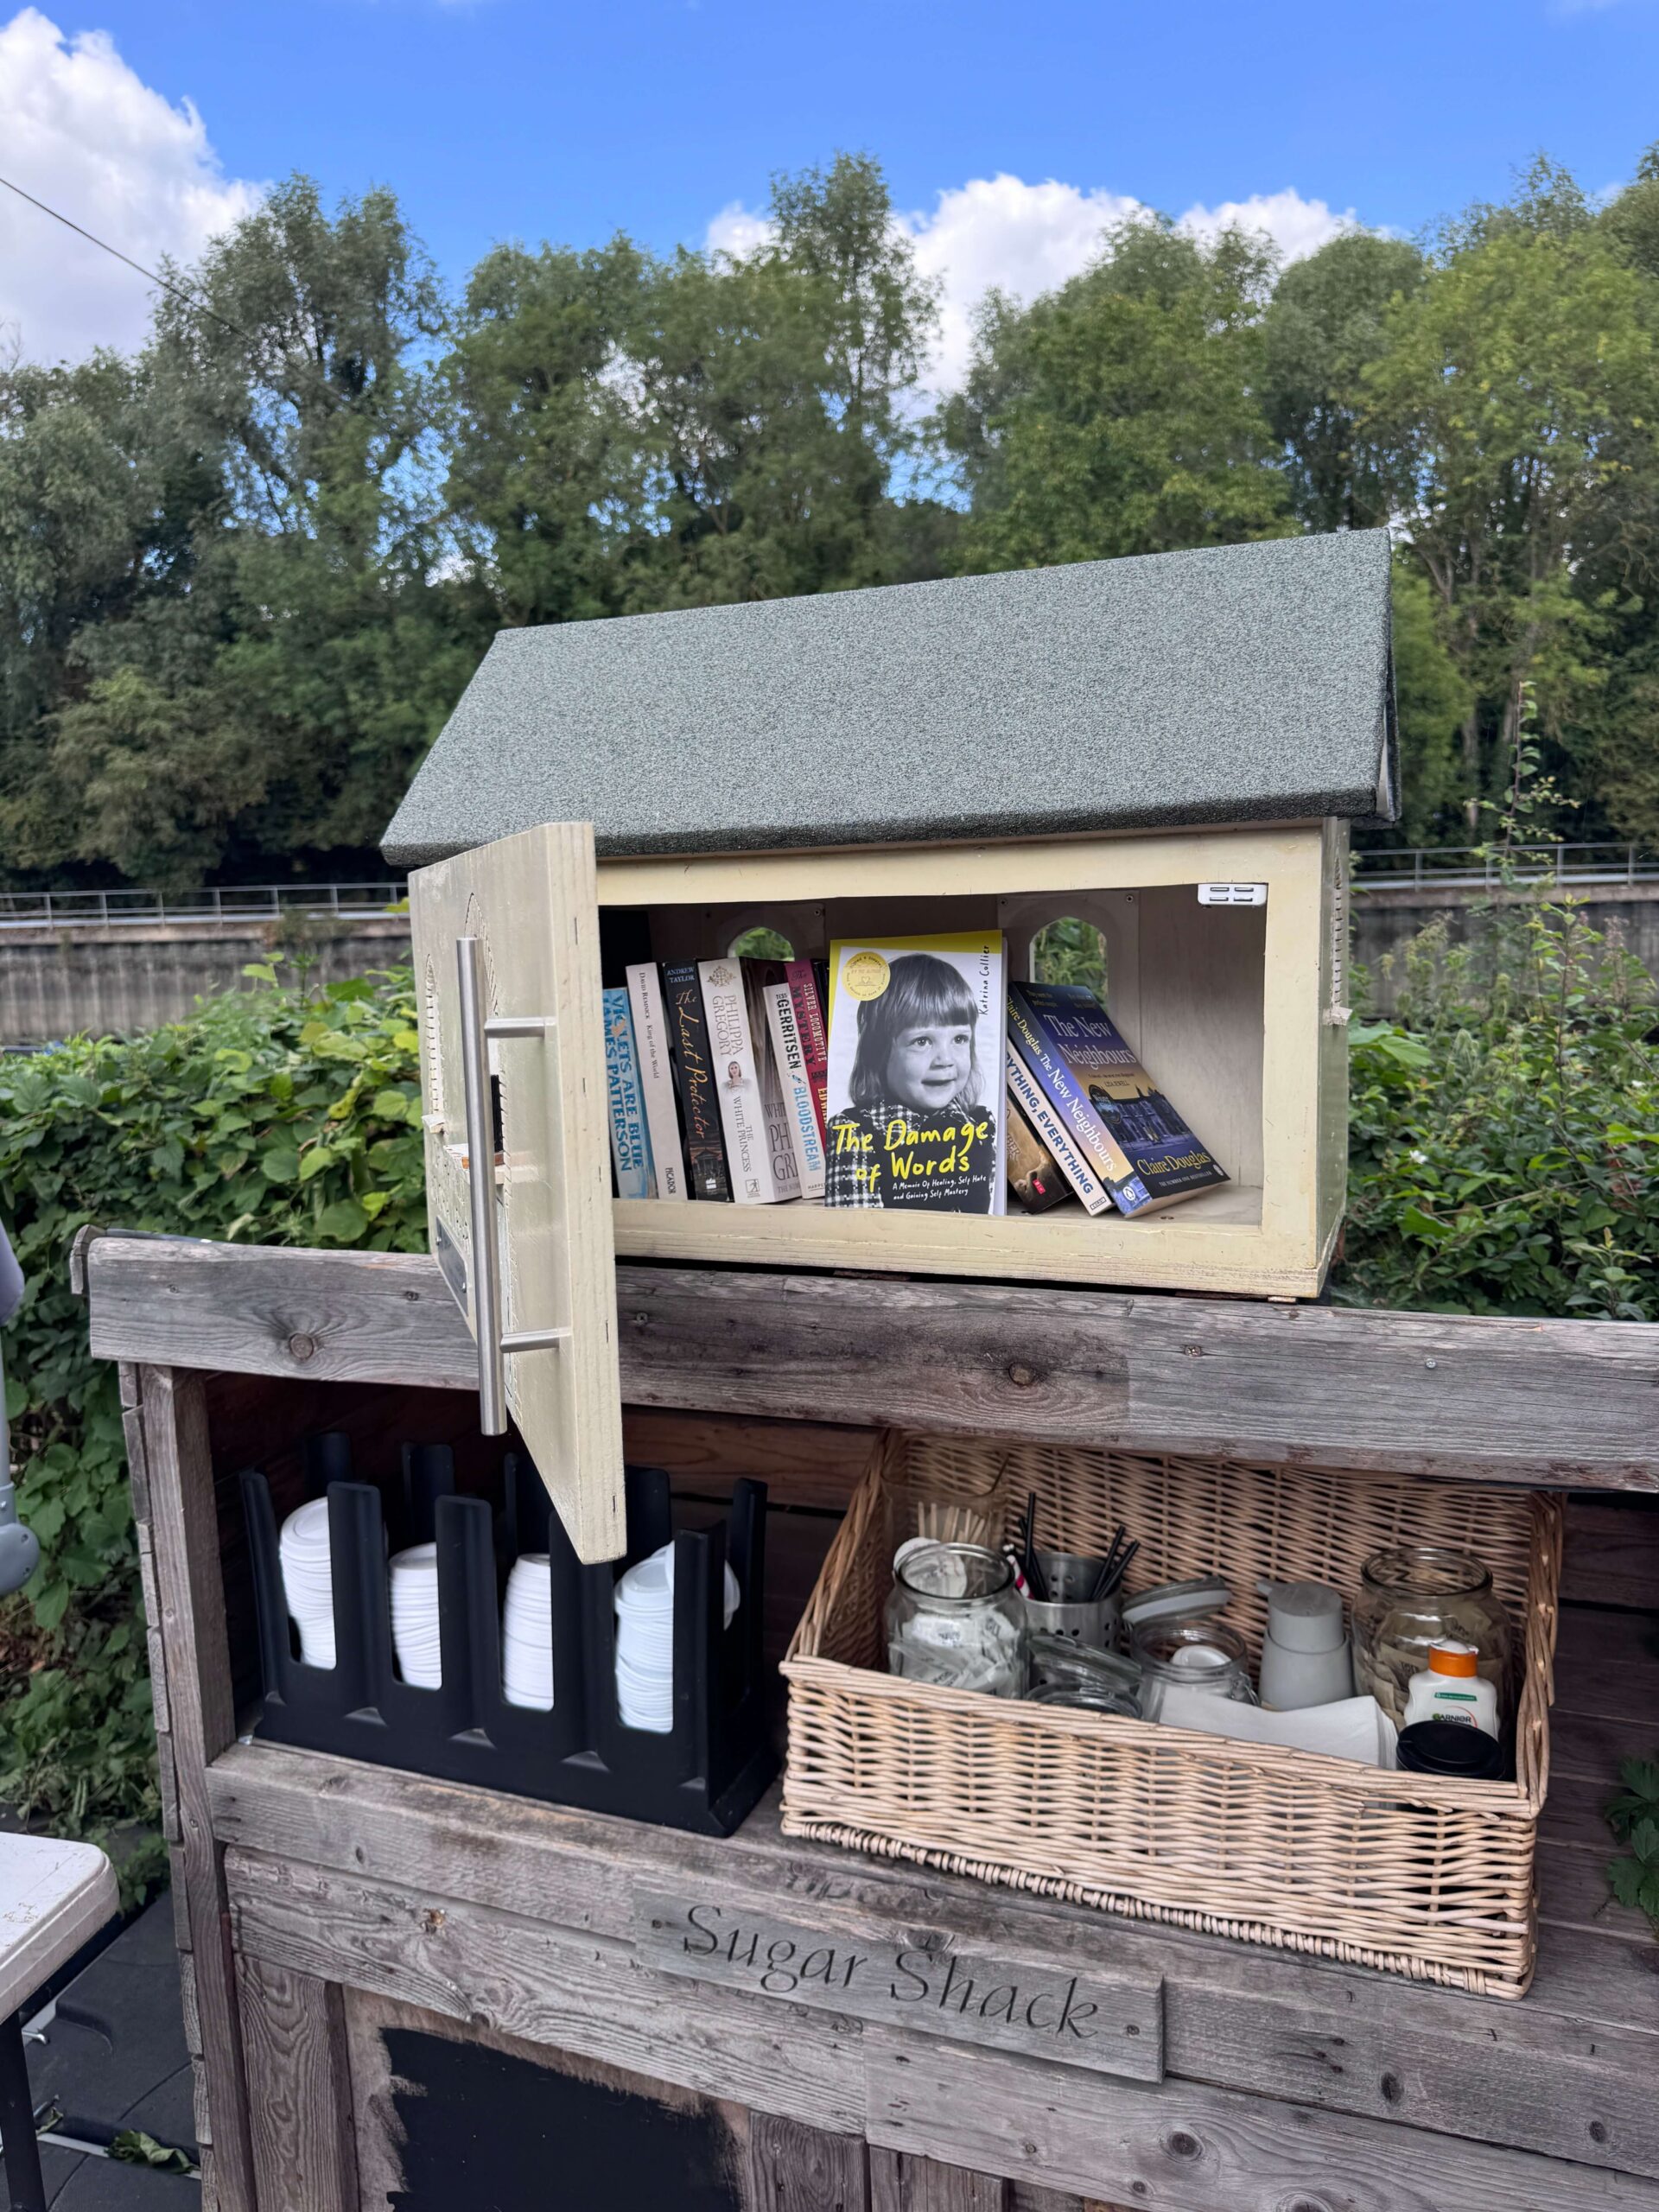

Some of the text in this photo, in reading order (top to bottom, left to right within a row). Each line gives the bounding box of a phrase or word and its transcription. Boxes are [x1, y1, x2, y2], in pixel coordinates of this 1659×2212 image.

[667, 967, 695, 976] ANDREW
[670, 975, 695, 983] TAYLOR
[978, 945, 989, 1015] Katrina Collier
[676, 988, 697, 1005] The
[804, 982, 817, 1011] SILVER
[712, 995, 732, 1056] GREGORY
[724, 995, 744, 1055] PHILIPPA
[1043, 1014, 1113, 1038] The New
[678, 1006, 709, 1140] Last Protector
[1057, 1043, 1137, 1071] Neighbours
[621, 1079, 638, 1117] ARE
[1017, 1020, 1043, 1055] Douglas
[1039, 1053, 1052, 1071] The
[1047, 1068, 1071, 1098] New
[1066, 1097, 1116, 1172] Neighbours
[607, 1065, 632, 1172] PATTERSON
[733, 1096, 752, 1173] WHITE PRINCESS
[793, 1086, 821, 1172] BLOODSTREAM
[832, 1122, 874, 1155] The
[884, 1119, 988, 1157] Damage
[1007, 1052, 1093, 1194] YTHING, EVERYTHING
[628, 1122, 643, 1169] BLUE
[1136, 1150, 1211, 1175] Claire Douglas
[665, 1167, 677, 1194] PICADOR
[855, 1145, 970, 1192] of Words
[893, 1182, 898, 1191] A
[899, 1181, 920, 1191] Memoir
[958, 1176, 970, 1185] Self
[972, 1174, 987, 1183] Hate
[906, 1191, 928, 1201] Gaining
[930, 1190, 942, 1198] Self
[944, 1188, 969, 1197] Mastery
[683, 1904, 1098, 2039] Sugar Shack
